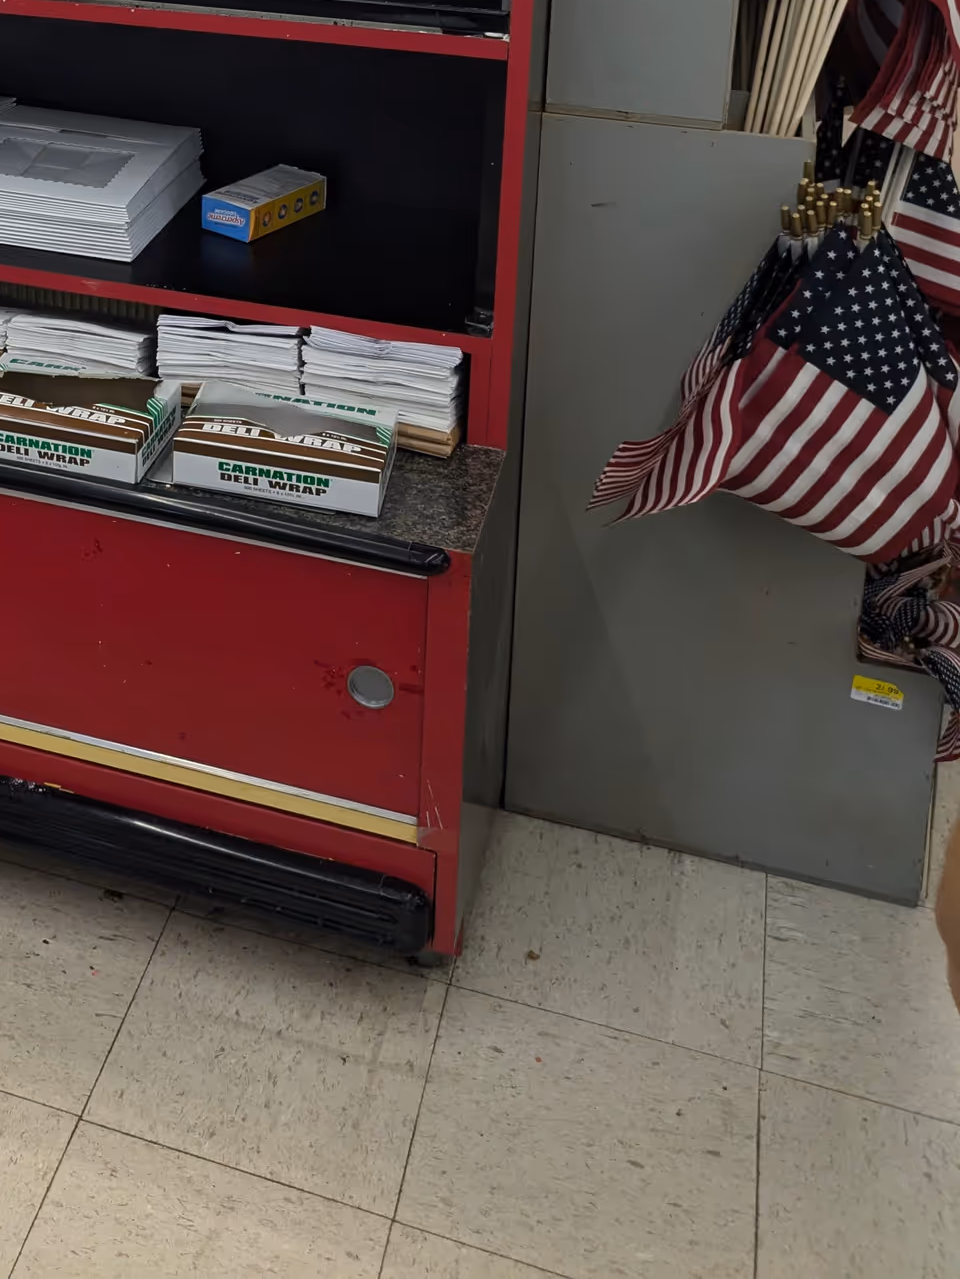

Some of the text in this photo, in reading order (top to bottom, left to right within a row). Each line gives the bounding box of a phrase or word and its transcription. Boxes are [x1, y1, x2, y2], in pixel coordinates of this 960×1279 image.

[9, 358, 87, 372] CARN
[46, 406, 126, 424] WRAP
[255, 392, 376, 416] NATION
[202, 423, 261, 437] DELI
[275, 433, 362, 453] WRAP
[37, 450, 90, 467] WRAP
[218, 461, 330, 488] CARNATION
[220, 472, 327, 497] DELI WRAP
